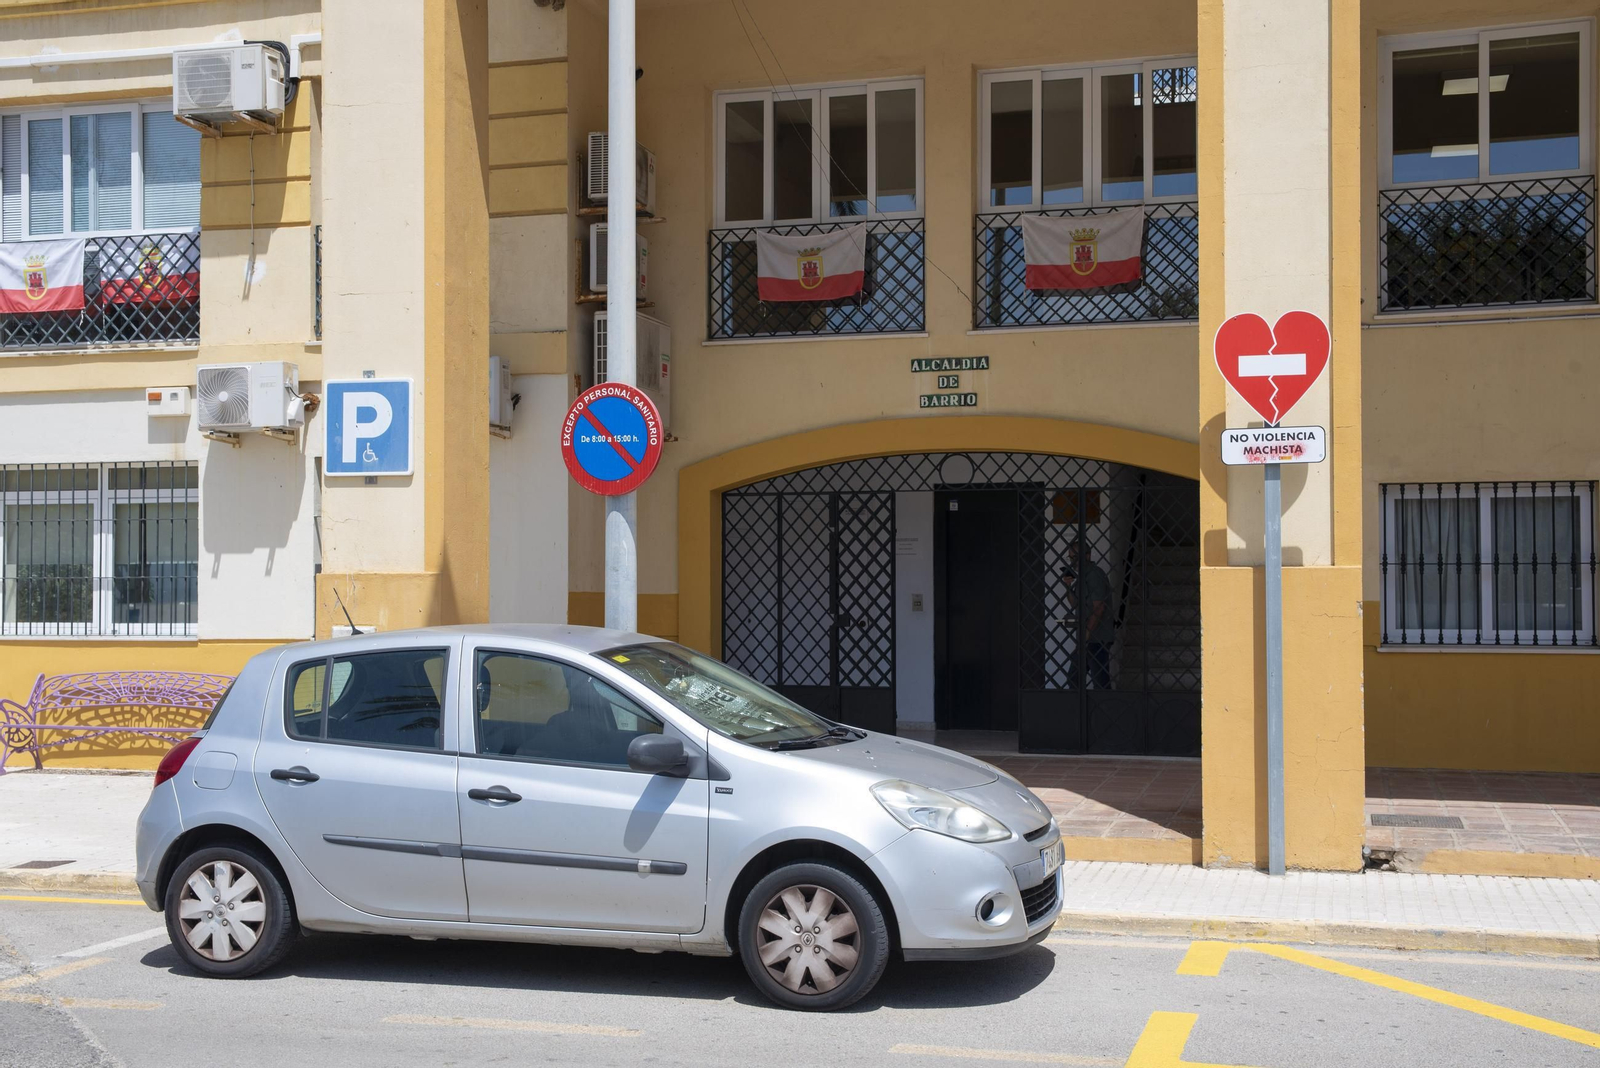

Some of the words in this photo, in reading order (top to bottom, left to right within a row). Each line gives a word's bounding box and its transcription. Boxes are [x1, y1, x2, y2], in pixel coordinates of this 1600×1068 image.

[911, 357, 988, 371] ALCALDIA
[939, 376, 958, 388] DE
[920, 394, 976, 407] BARRIO
[563, 402, 584, 446] EXCEPTO
[583, 387, 632, 405] PERSONAL
[632, 396, 658, 446] SANITARIO
[342, 391, 393, 463] P
[581, 435, 590, 443] De
[591, 435, 606, 443] 8:00
[613, 435, 631, 443] 15:00
[632, 435, 639, 443] h.
[1230, 434, 1249, 443] NO
[1252, 432, 1316, 442] VIOLENCIA
[1243, 444, 1303, 455] MACHISTA
